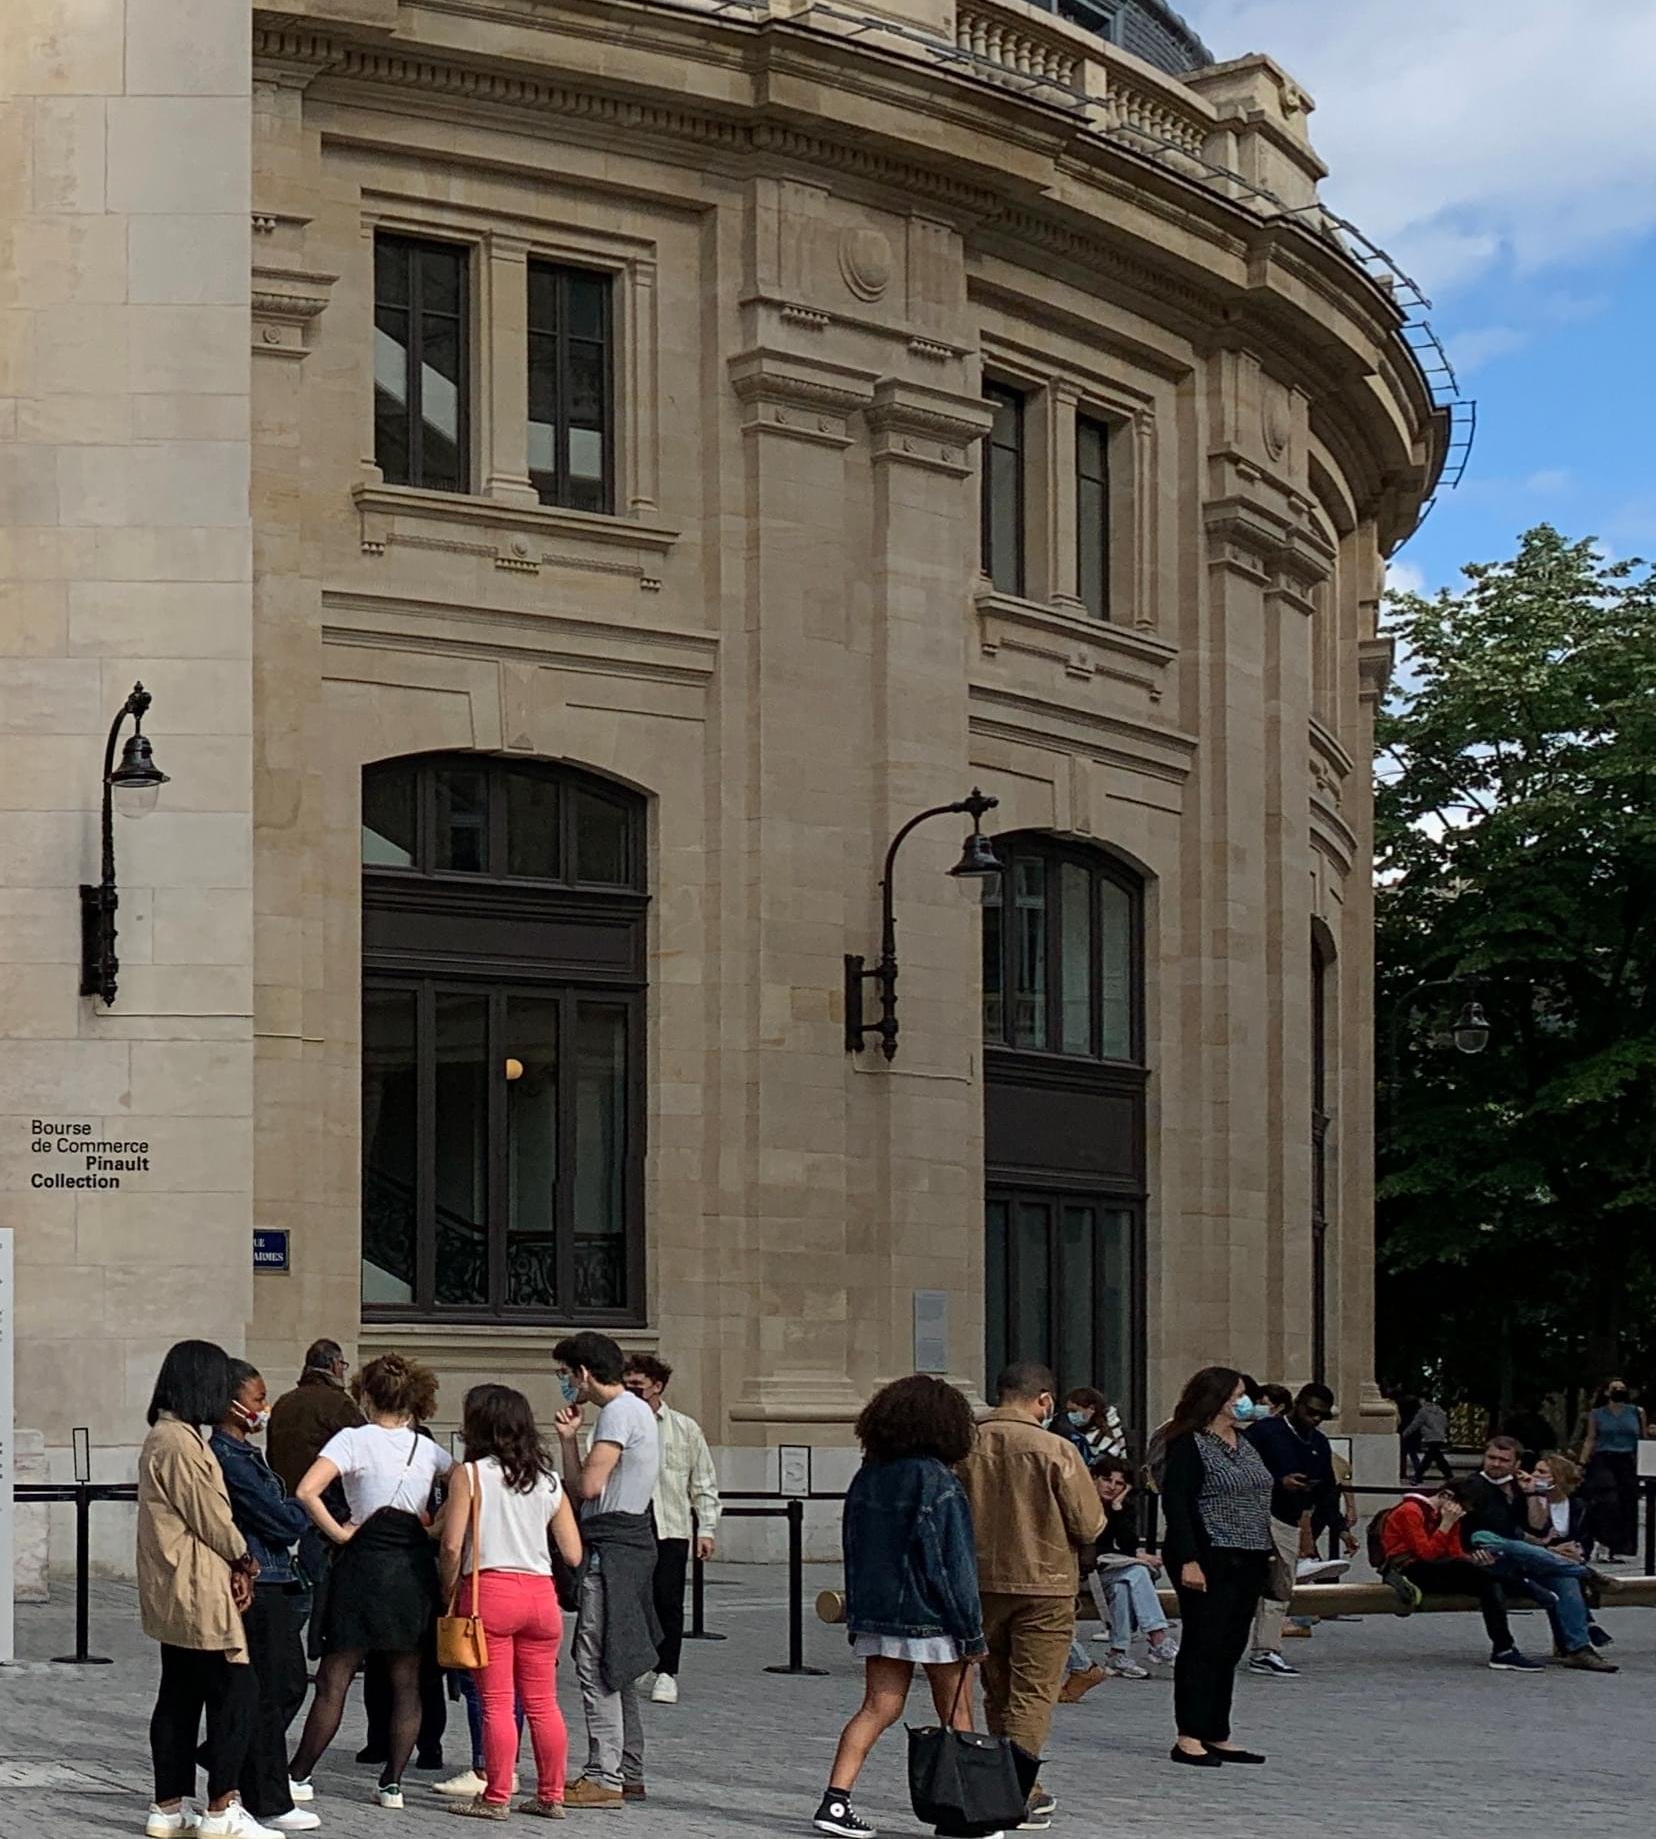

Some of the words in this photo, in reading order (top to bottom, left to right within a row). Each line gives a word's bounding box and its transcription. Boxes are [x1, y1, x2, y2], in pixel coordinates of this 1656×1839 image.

[31, 1119, 92, 1135] Bourse
[31, 1138, 52, 1153] de
[57, 1138, 149, 1154] Commerce
[86, 1156, 150, 1171] Pinault
[31, 1173, 120, 1188] Collection
[254, 1251, 285, 1262] ARMES
